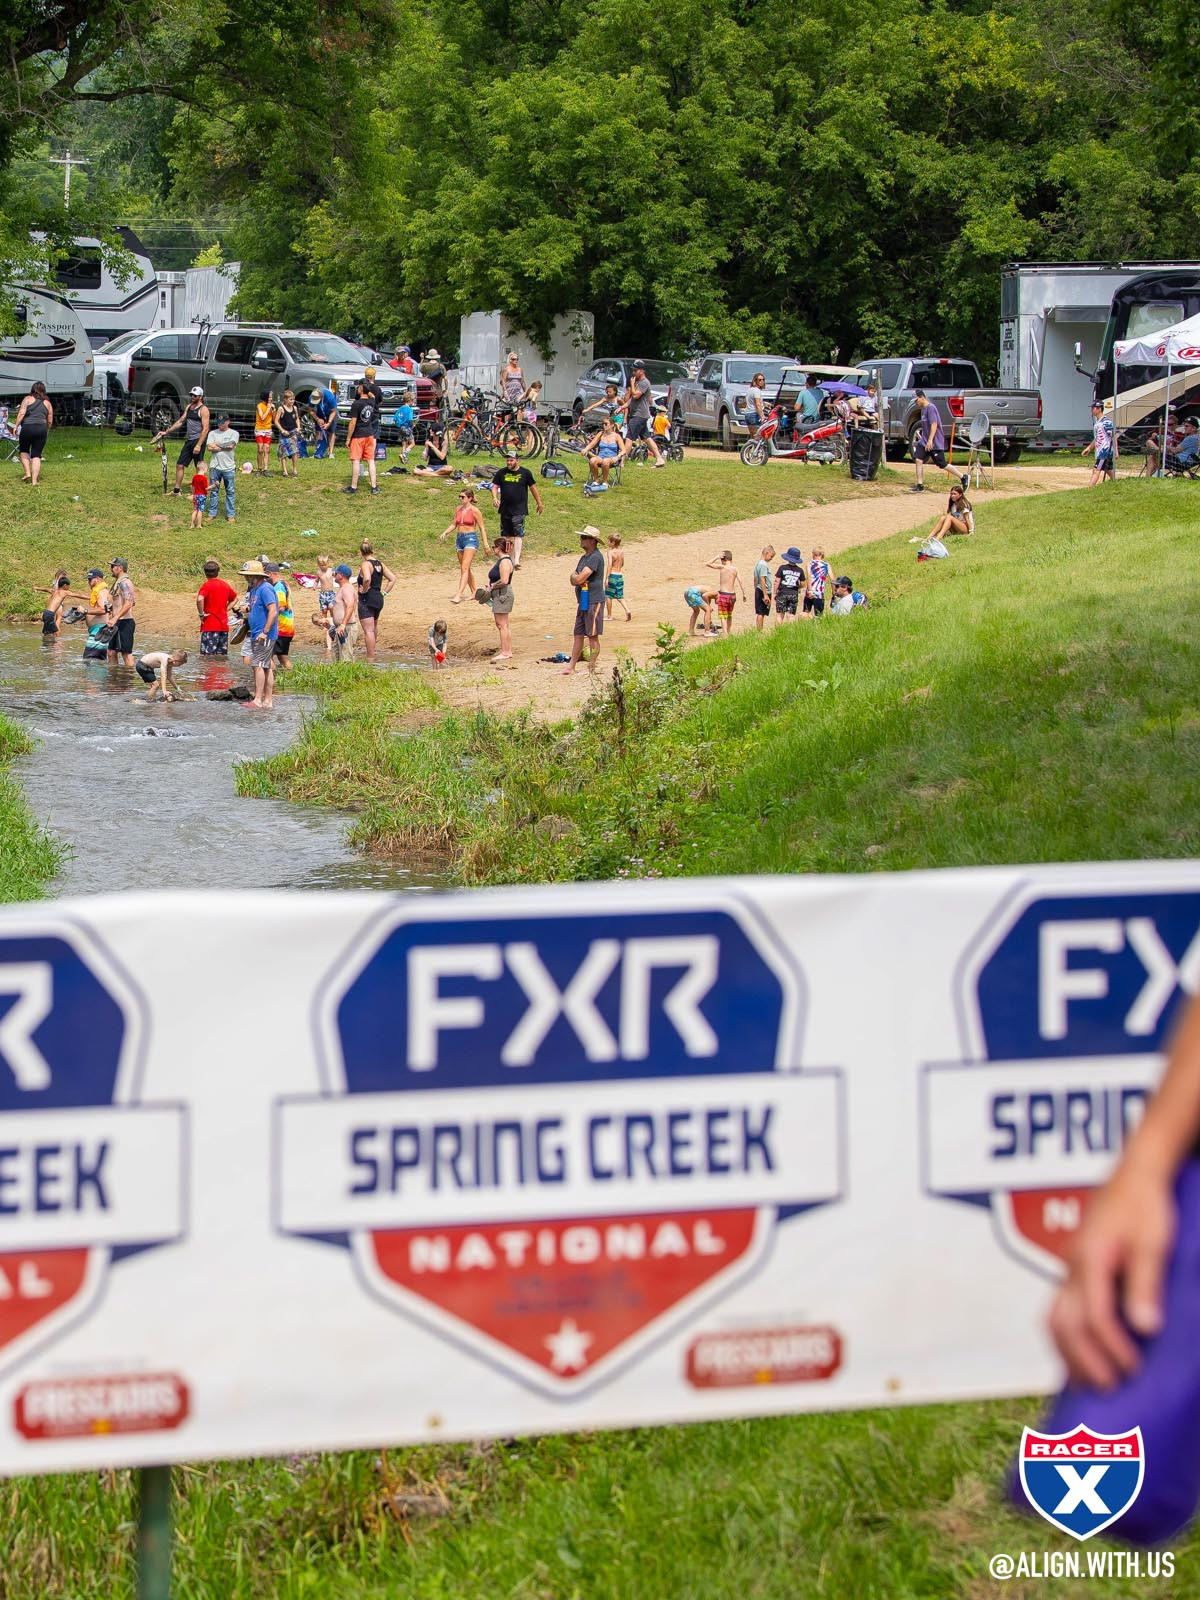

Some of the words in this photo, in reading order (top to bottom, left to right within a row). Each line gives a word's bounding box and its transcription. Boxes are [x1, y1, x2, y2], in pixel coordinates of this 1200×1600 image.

[36, 322, 75, 333] Passport
[406, 934, 719, 1071] FXR
[1038, 917, 1200, 1041] FX
[348, 1115, 567, 1195] SPRING
[585, 1105, 778, 1184] CREEK
[408, 1220, 725, 1272] NATIONAL
